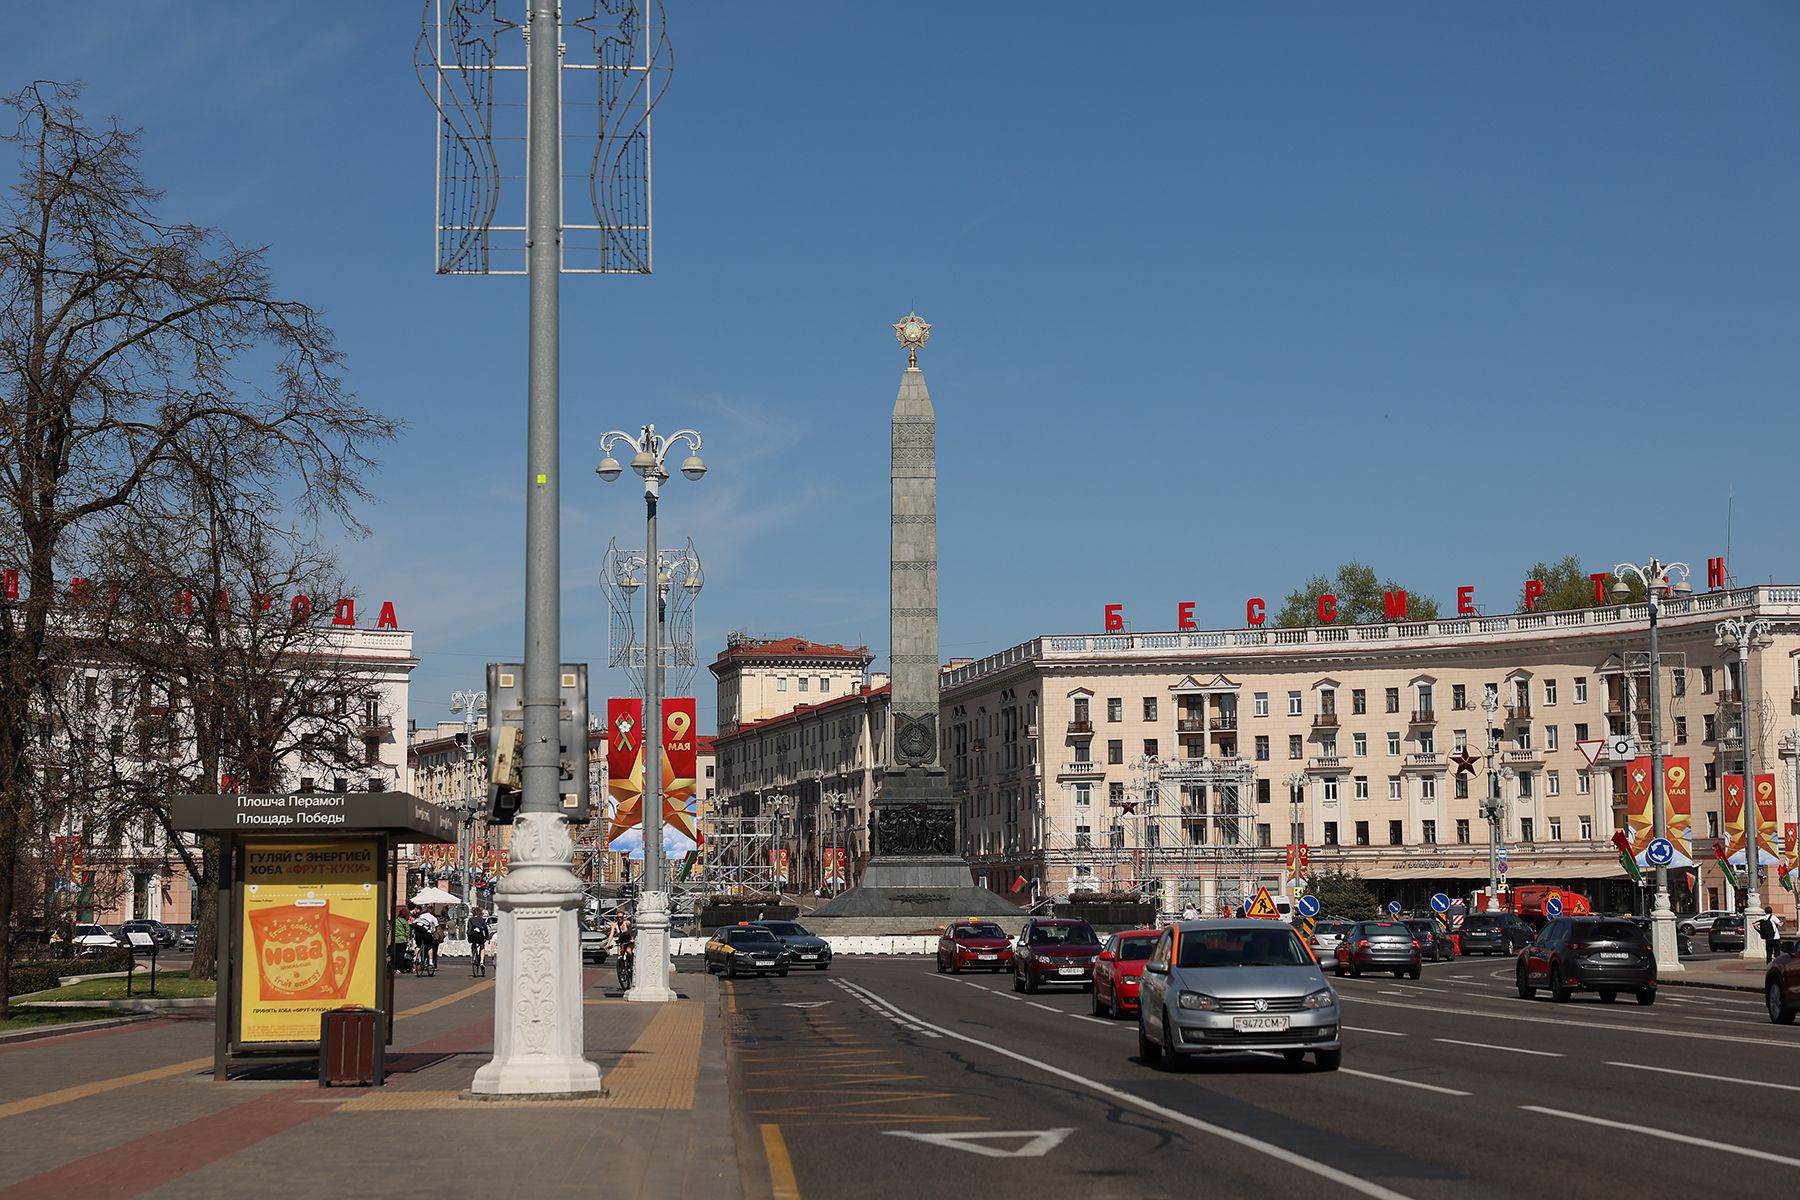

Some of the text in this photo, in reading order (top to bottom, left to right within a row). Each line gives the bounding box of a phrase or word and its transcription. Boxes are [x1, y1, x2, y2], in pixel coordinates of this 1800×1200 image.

[1104, 557, 1725, 631] БЕССМЕРТН
[667, 711, 691, 741] 9
[668, 742, 691, 751] МАЯ
[1667, 766, 1686, 788] 9
[1758, 782, 1773, 800] 9
[237, 795, 345, 808] Плошча Перамогі
[236, 812, 345, 825] Площадь Победы
[250, 849, 371, 863] ГУЛЯЙ С ЭНЕРГИЕЙ
[250, 865, 283, 875] ХОБА
